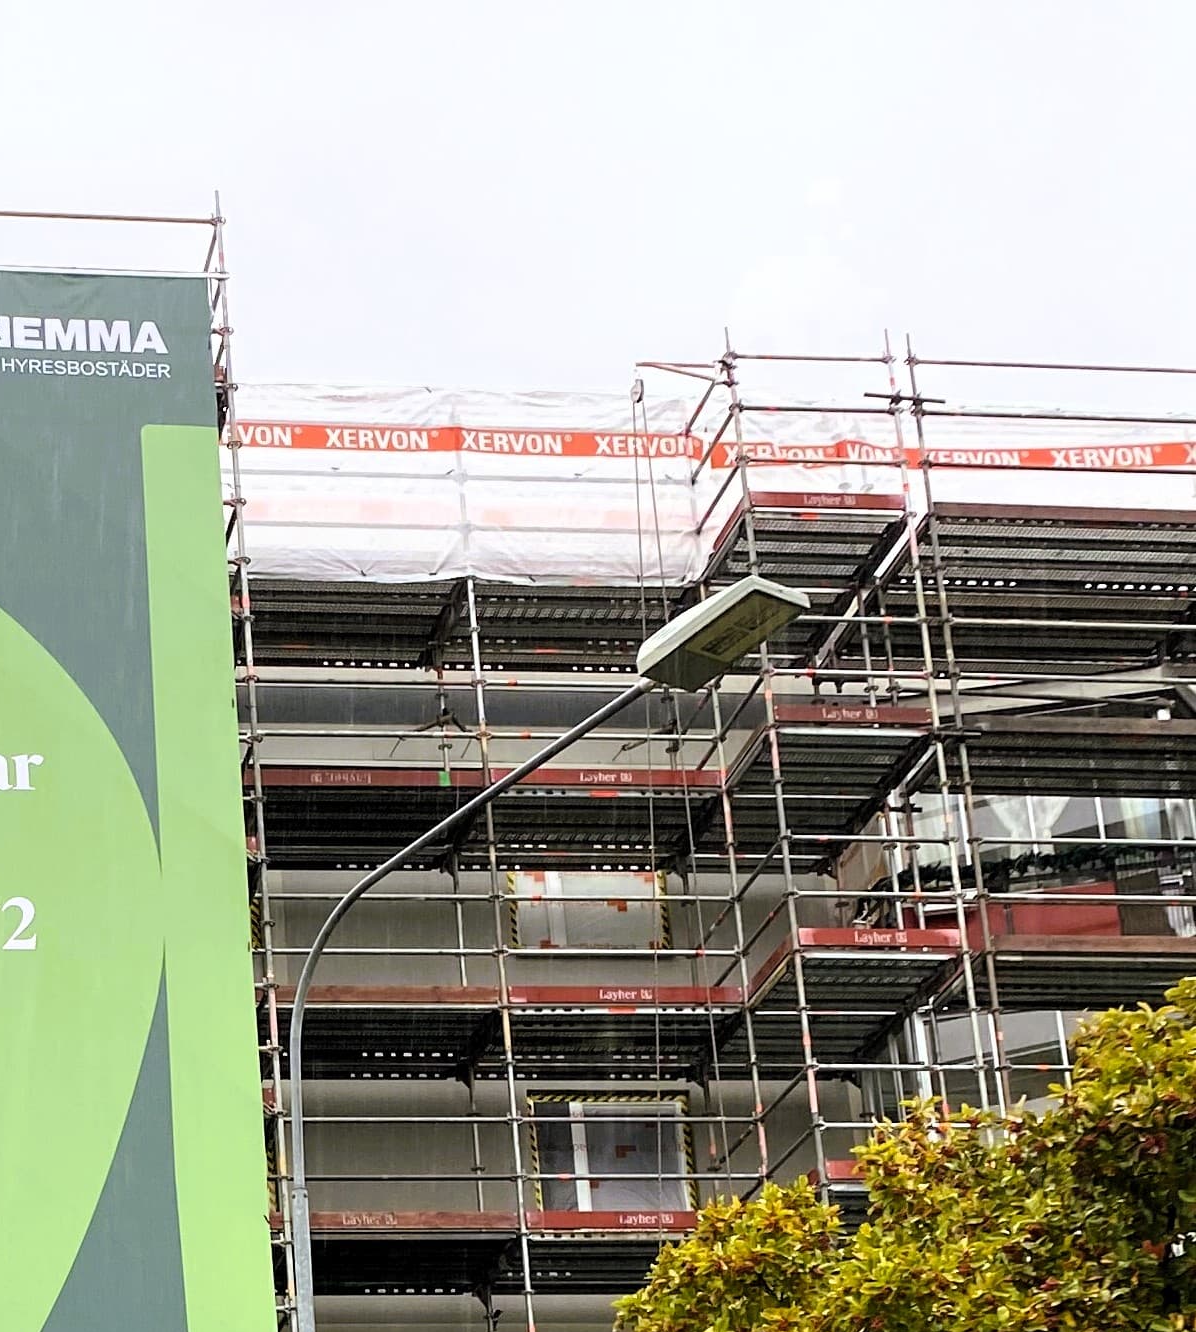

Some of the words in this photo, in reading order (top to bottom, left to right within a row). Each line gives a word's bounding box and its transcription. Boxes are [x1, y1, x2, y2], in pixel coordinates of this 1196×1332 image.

[1, 357, 172, 379] HYRESBOSTÄDER
[324, 427, 430, 451] XERVON
[460, 430, 563, 454] XERVON
[594, 434, 696, 457] XERVON
[1050, 446, 1154, 468] XERVON
[579, 772, 617, 785] Layher
[1, 896, 37, 950] 2
[854, 931, 893, 945] Layher
[599, 989, 638, 1002] Layher
[619, 1213, 658, 1227] Layher
